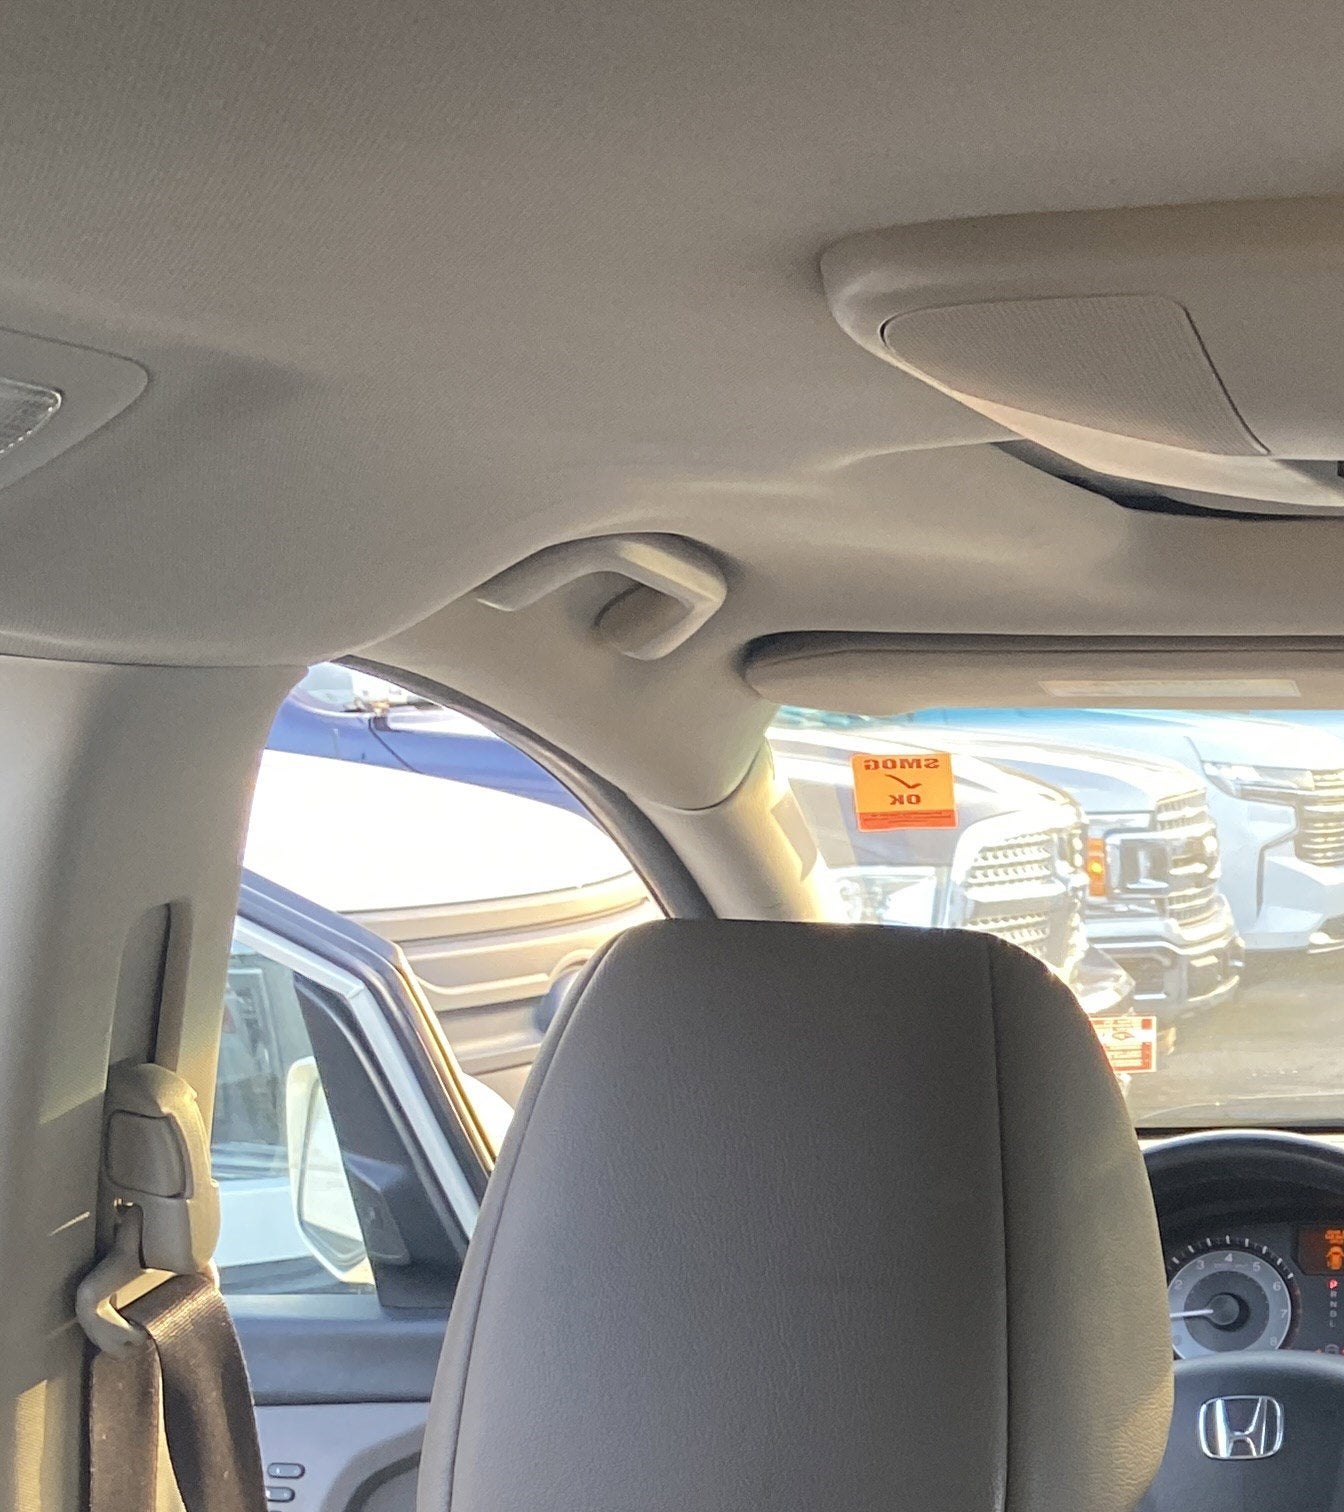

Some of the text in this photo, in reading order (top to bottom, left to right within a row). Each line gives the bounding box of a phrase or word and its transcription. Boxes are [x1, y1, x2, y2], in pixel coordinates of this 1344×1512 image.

[1224, 1252, 1233, 1263] 4
[1252, 1261, 1261, 1272] 5
[1273, 1280, 1282, 1292] 6
